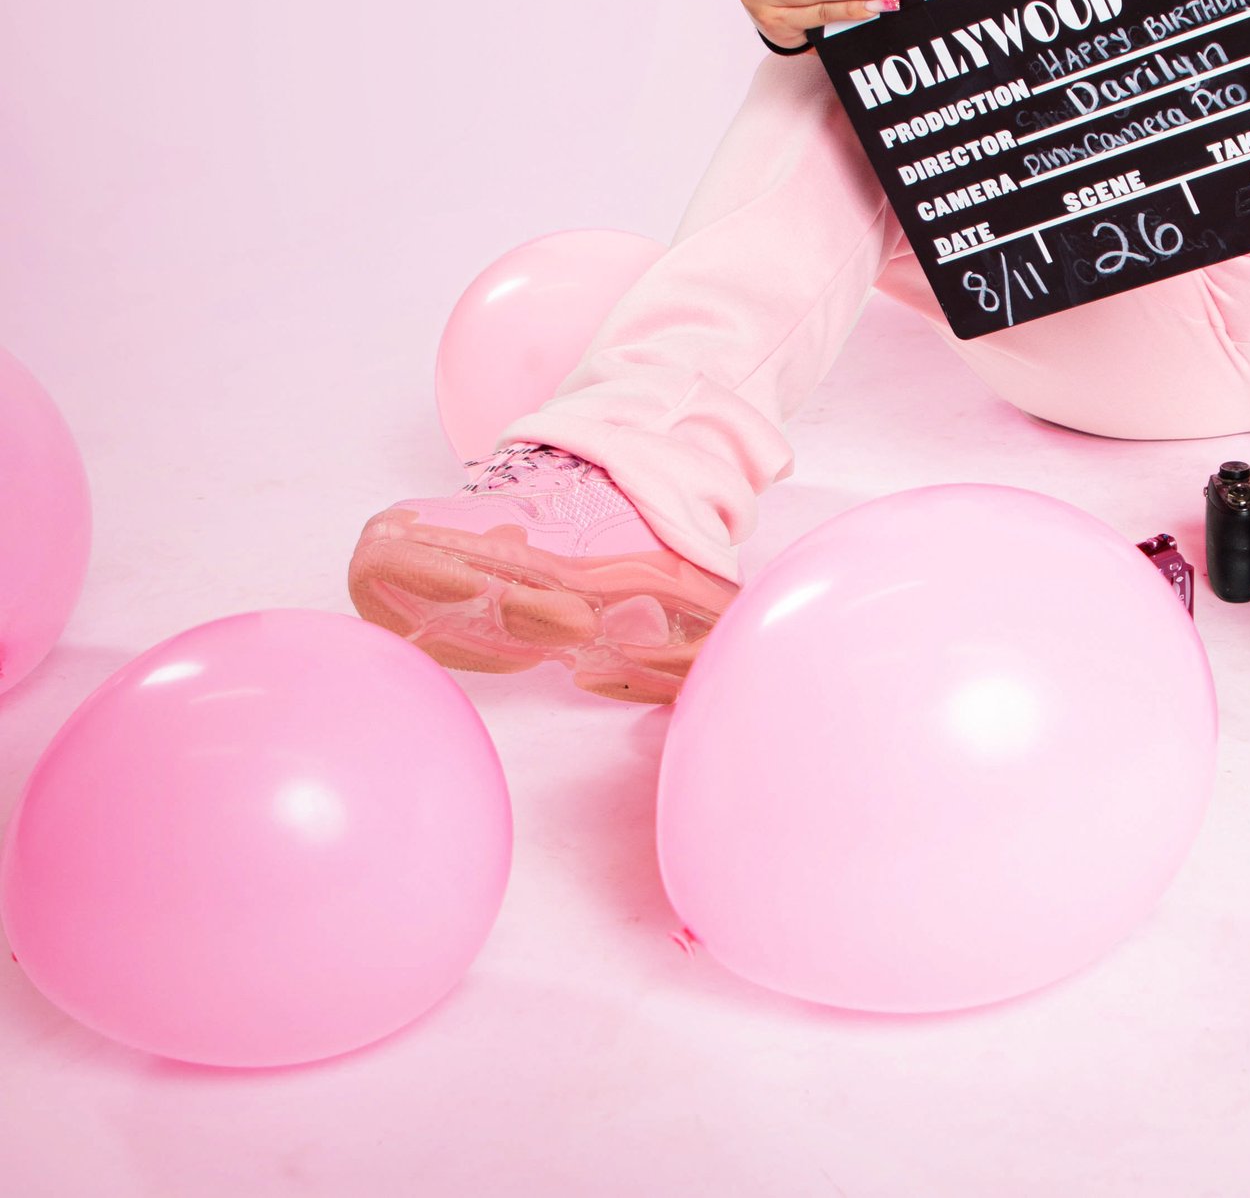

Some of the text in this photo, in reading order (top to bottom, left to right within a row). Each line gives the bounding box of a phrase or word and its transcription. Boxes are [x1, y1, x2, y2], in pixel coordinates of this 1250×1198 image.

[1066, 42, 1229, 116] Darilyn
[1190, 83, 1248, 117] Pro
[879, 78, 1031, 149] PRODUCTION
[897, 129, 1018, 186] DIRECTOR
[916, 173, 1018, 222] CAMERA
[1062, 170, 1146, 213] SCENE
[933, 221, 996, 257] DATE
[1092, 212, 1184, 274] 26
[963, 251, 1049, 327] 8/11
